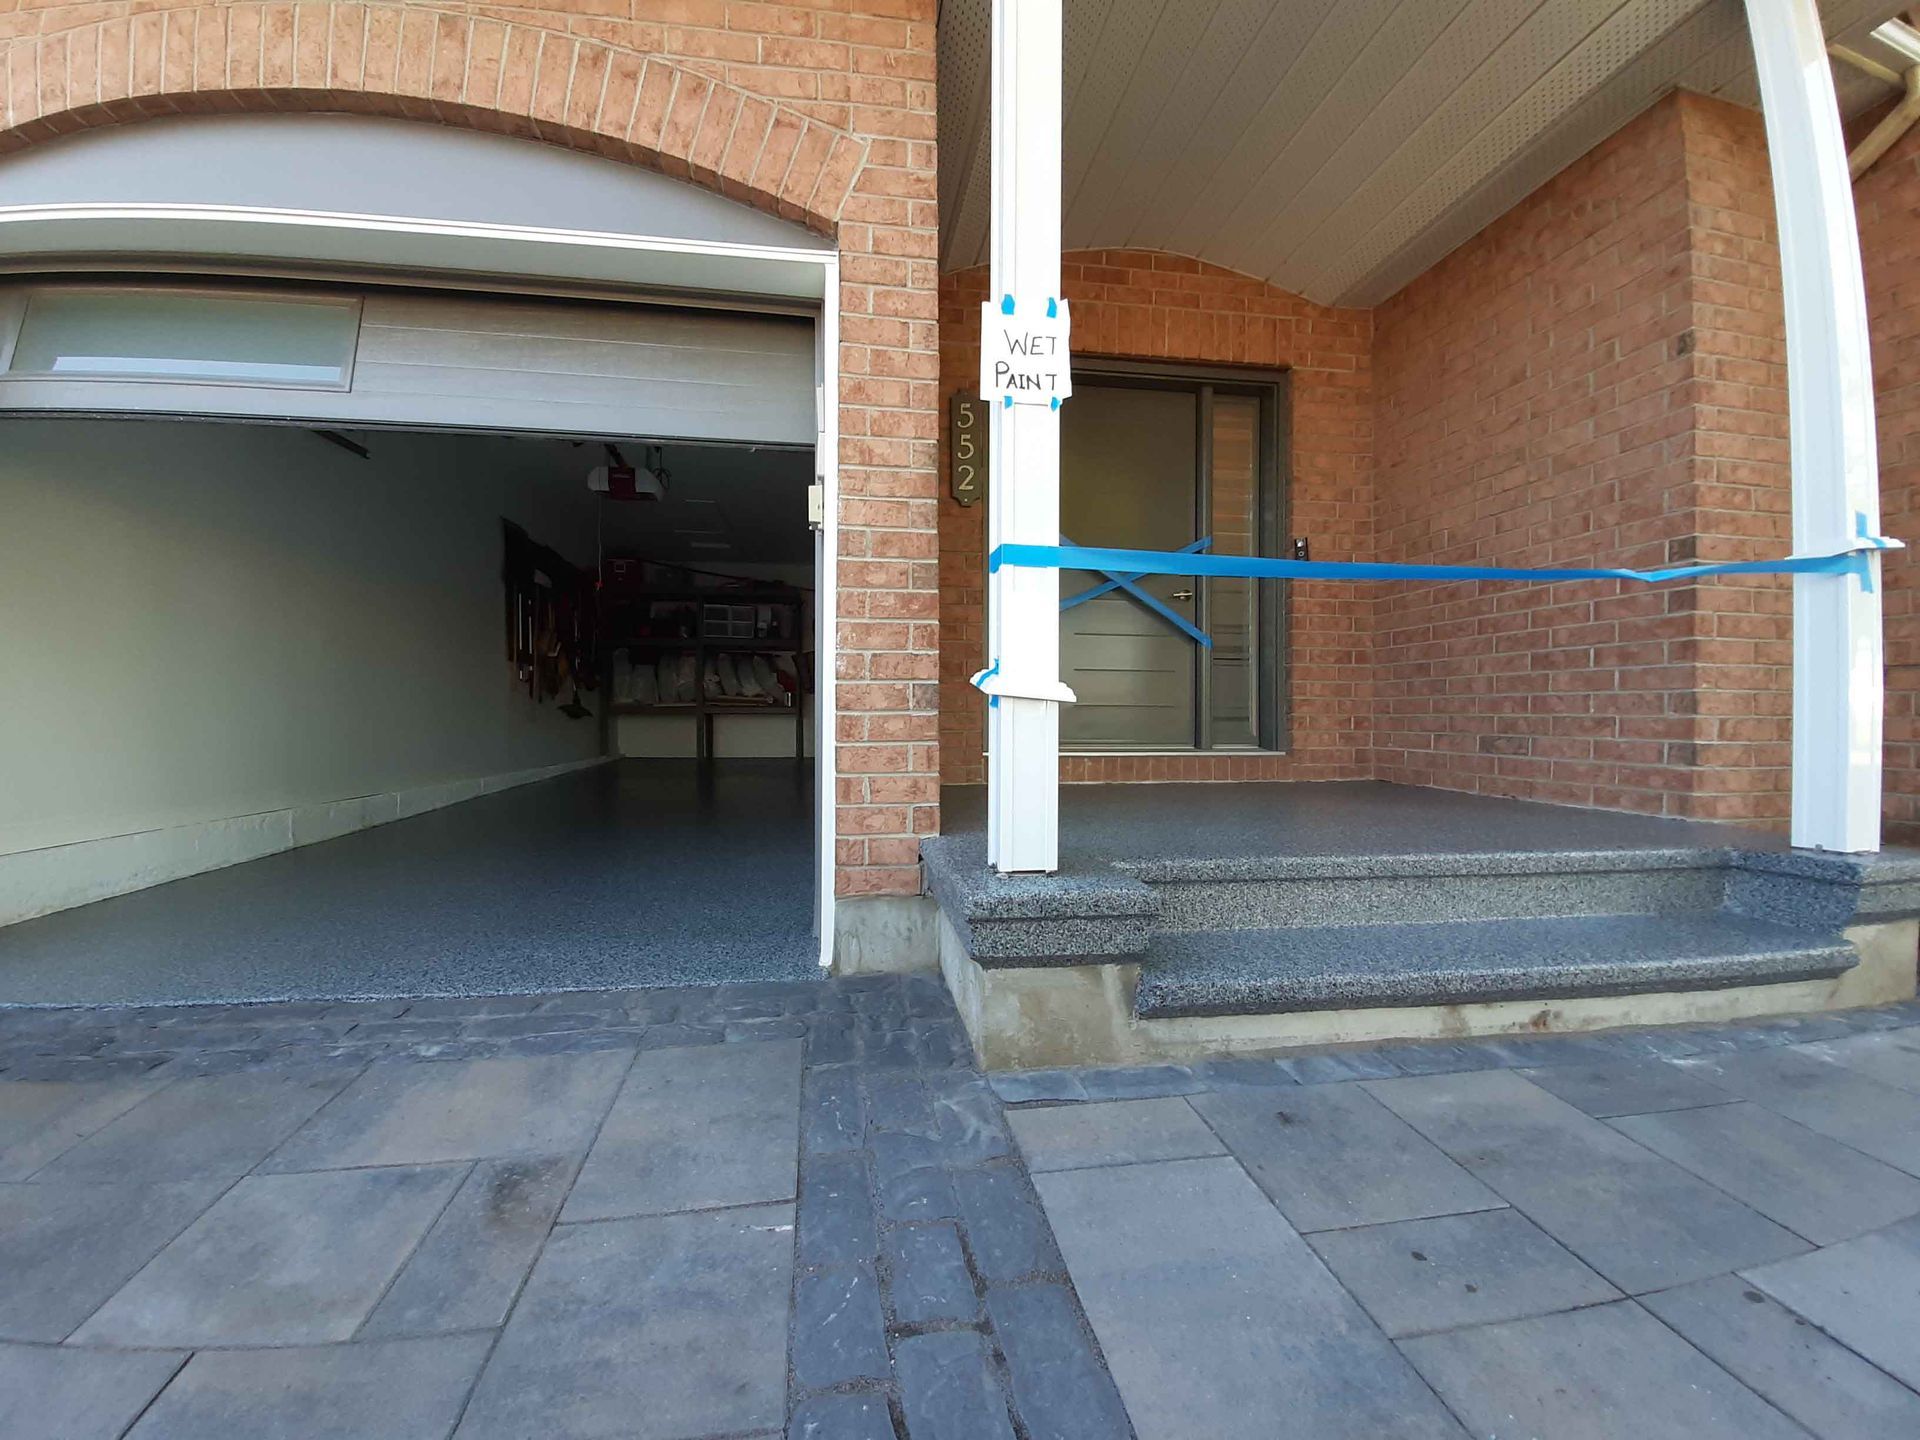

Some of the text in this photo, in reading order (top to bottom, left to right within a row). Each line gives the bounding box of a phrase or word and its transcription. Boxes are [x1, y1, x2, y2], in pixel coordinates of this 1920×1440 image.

[1003, 329, 1057, 355] WET
[995, 361, 1057, 390] PAINT
[957, 403, 975, 490] 552
